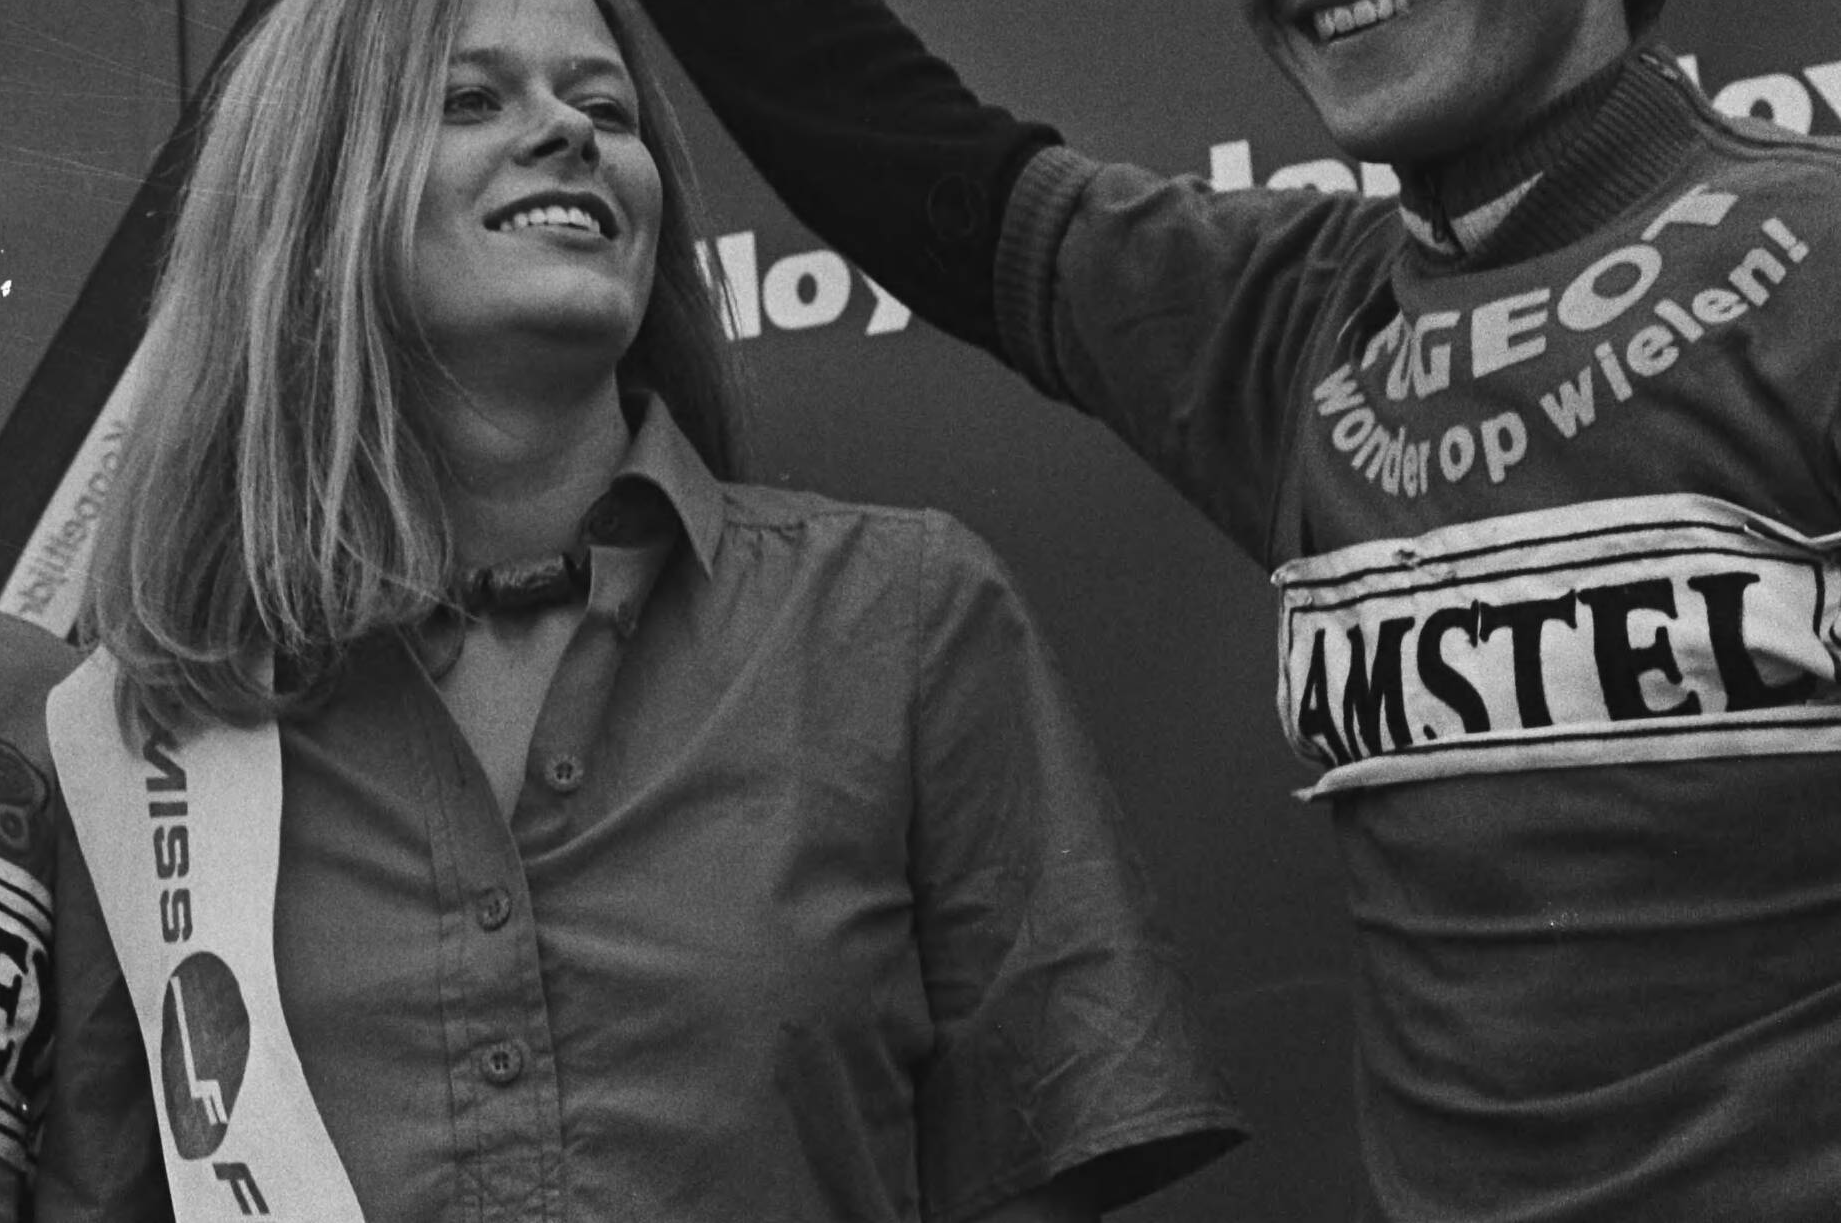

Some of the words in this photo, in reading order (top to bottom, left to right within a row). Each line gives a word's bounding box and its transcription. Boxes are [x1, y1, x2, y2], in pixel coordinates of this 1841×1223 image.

[1439, 411, 1528, 484] op
[1540, 217, 1809, 439] wielen!
[1296, 572, 1819, 766] AMSTEL
